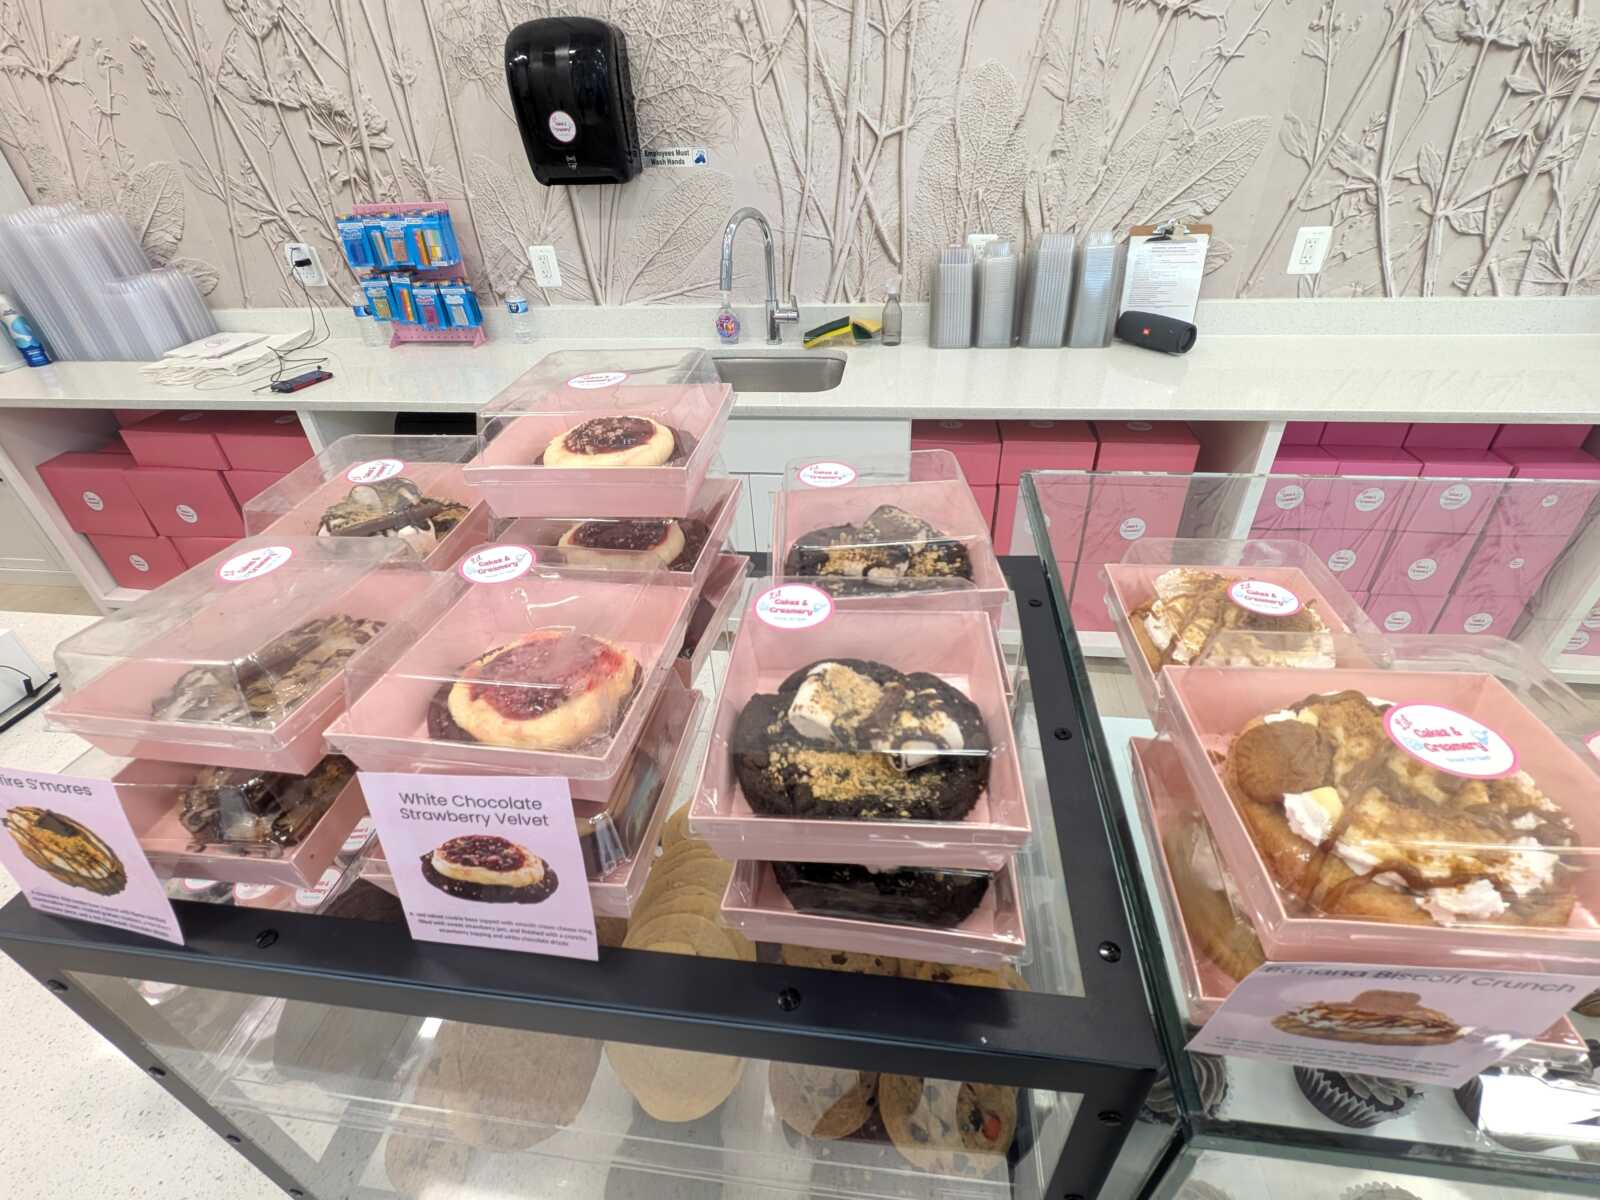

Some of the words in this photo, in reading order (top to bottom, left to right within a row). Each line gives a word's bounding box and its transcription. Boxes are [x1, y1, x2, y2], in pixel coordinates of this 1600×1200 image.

[644, 150, 675, 159] Employees
[769, 606, 813, 616] Creamery
[1413, 727, 1451, 738] Cakes
[1450, 726, 1463, 737] &
[1424, 741, 1489, 752] Creamery
[26, 778, 93, 796] S'mores
[398, 792, 448, 807] White
[452, 794, 542, 810] Chocolate
[400, 808, 490, 827] Strawberry
[496, 813, 550, 827] Velvet
[1472, 977, 1576, 993] Crunch
